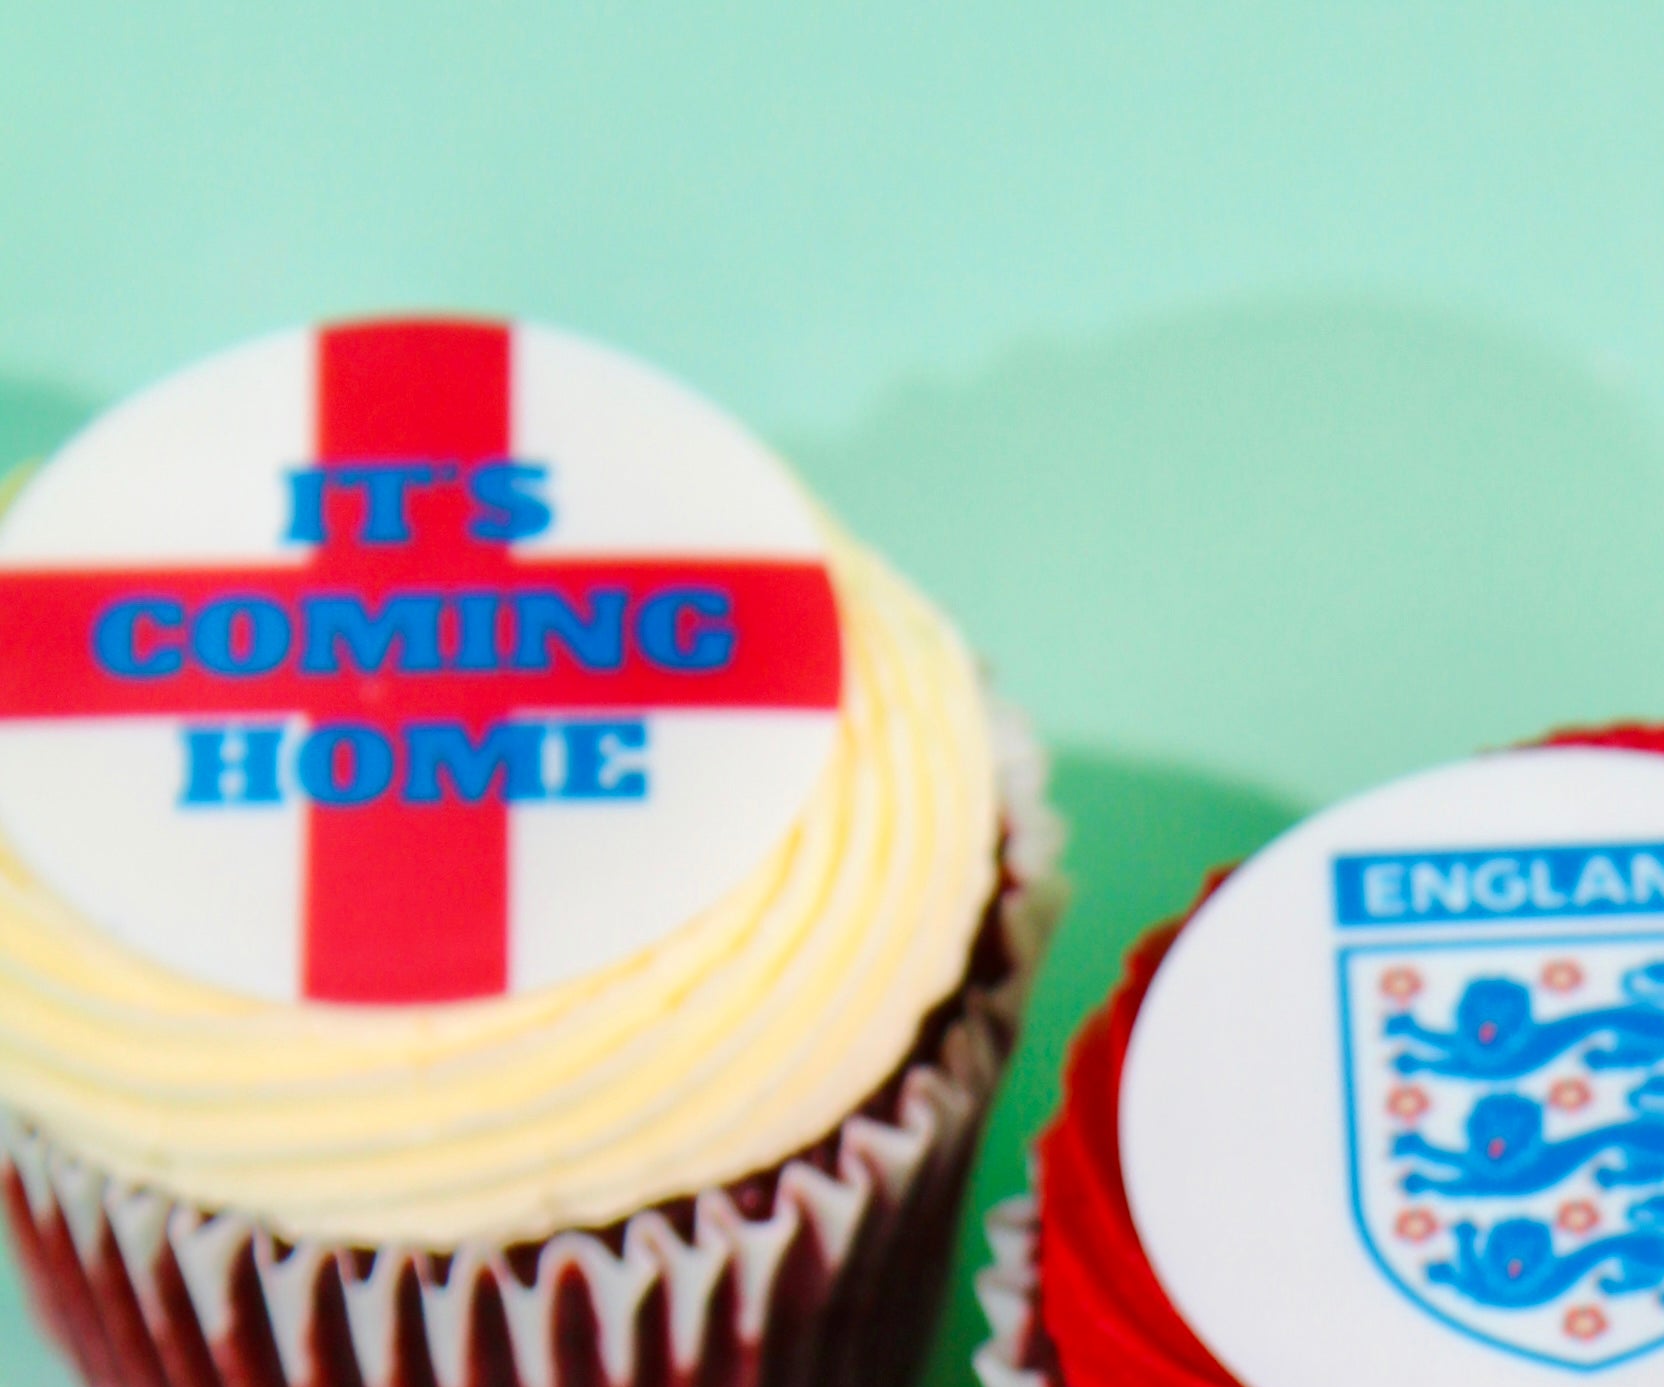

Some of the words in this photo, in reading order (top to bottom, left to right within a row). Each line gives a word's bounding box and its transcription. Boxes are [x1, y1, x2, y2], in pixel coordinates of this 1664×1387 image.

[280, 461, 553, 546] IT'S
[92, 588, 737, 678] COMING
[177, 717, 650, 809] HOME
